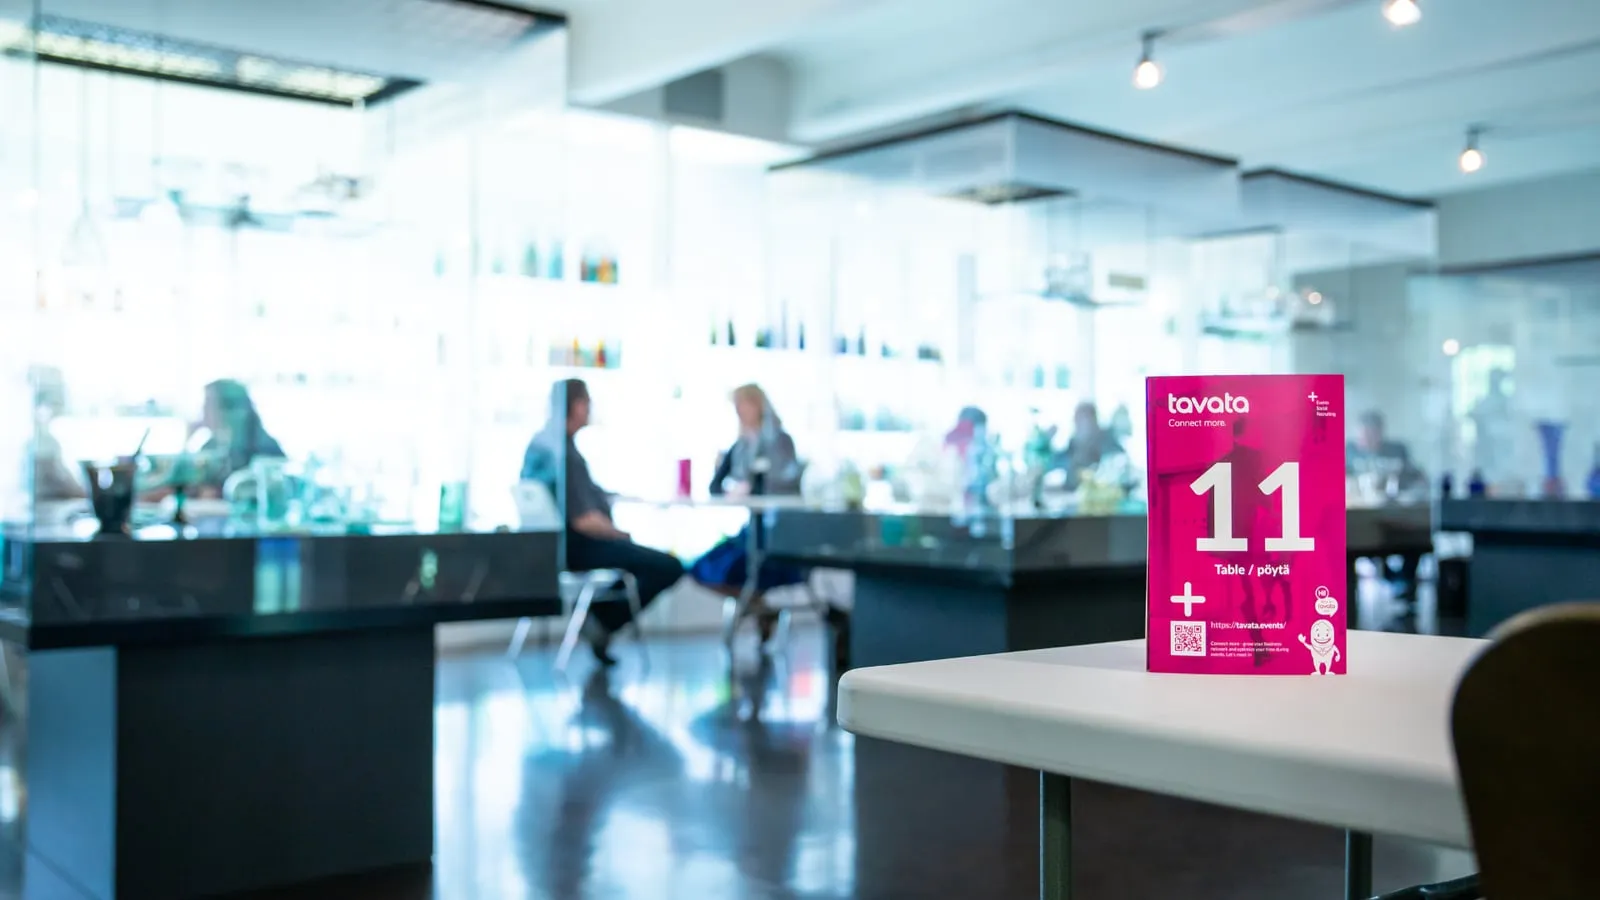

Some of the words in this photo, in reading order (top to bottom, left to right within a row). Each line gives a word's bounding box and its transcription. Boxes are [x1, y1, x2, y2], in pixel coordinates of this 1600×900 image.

[1168, 392, 1250, 414] tavata
[1168, 419, 1202, 428] Connect
[1189, 462, 1315, 551] 11
[1214, 564, 1246, 575] Table
[1248, 564, 1255, 576] /
[1257, 563, 1290, 577] pöytä
[1210, 621, 1287, 630] https://tavata.events/
